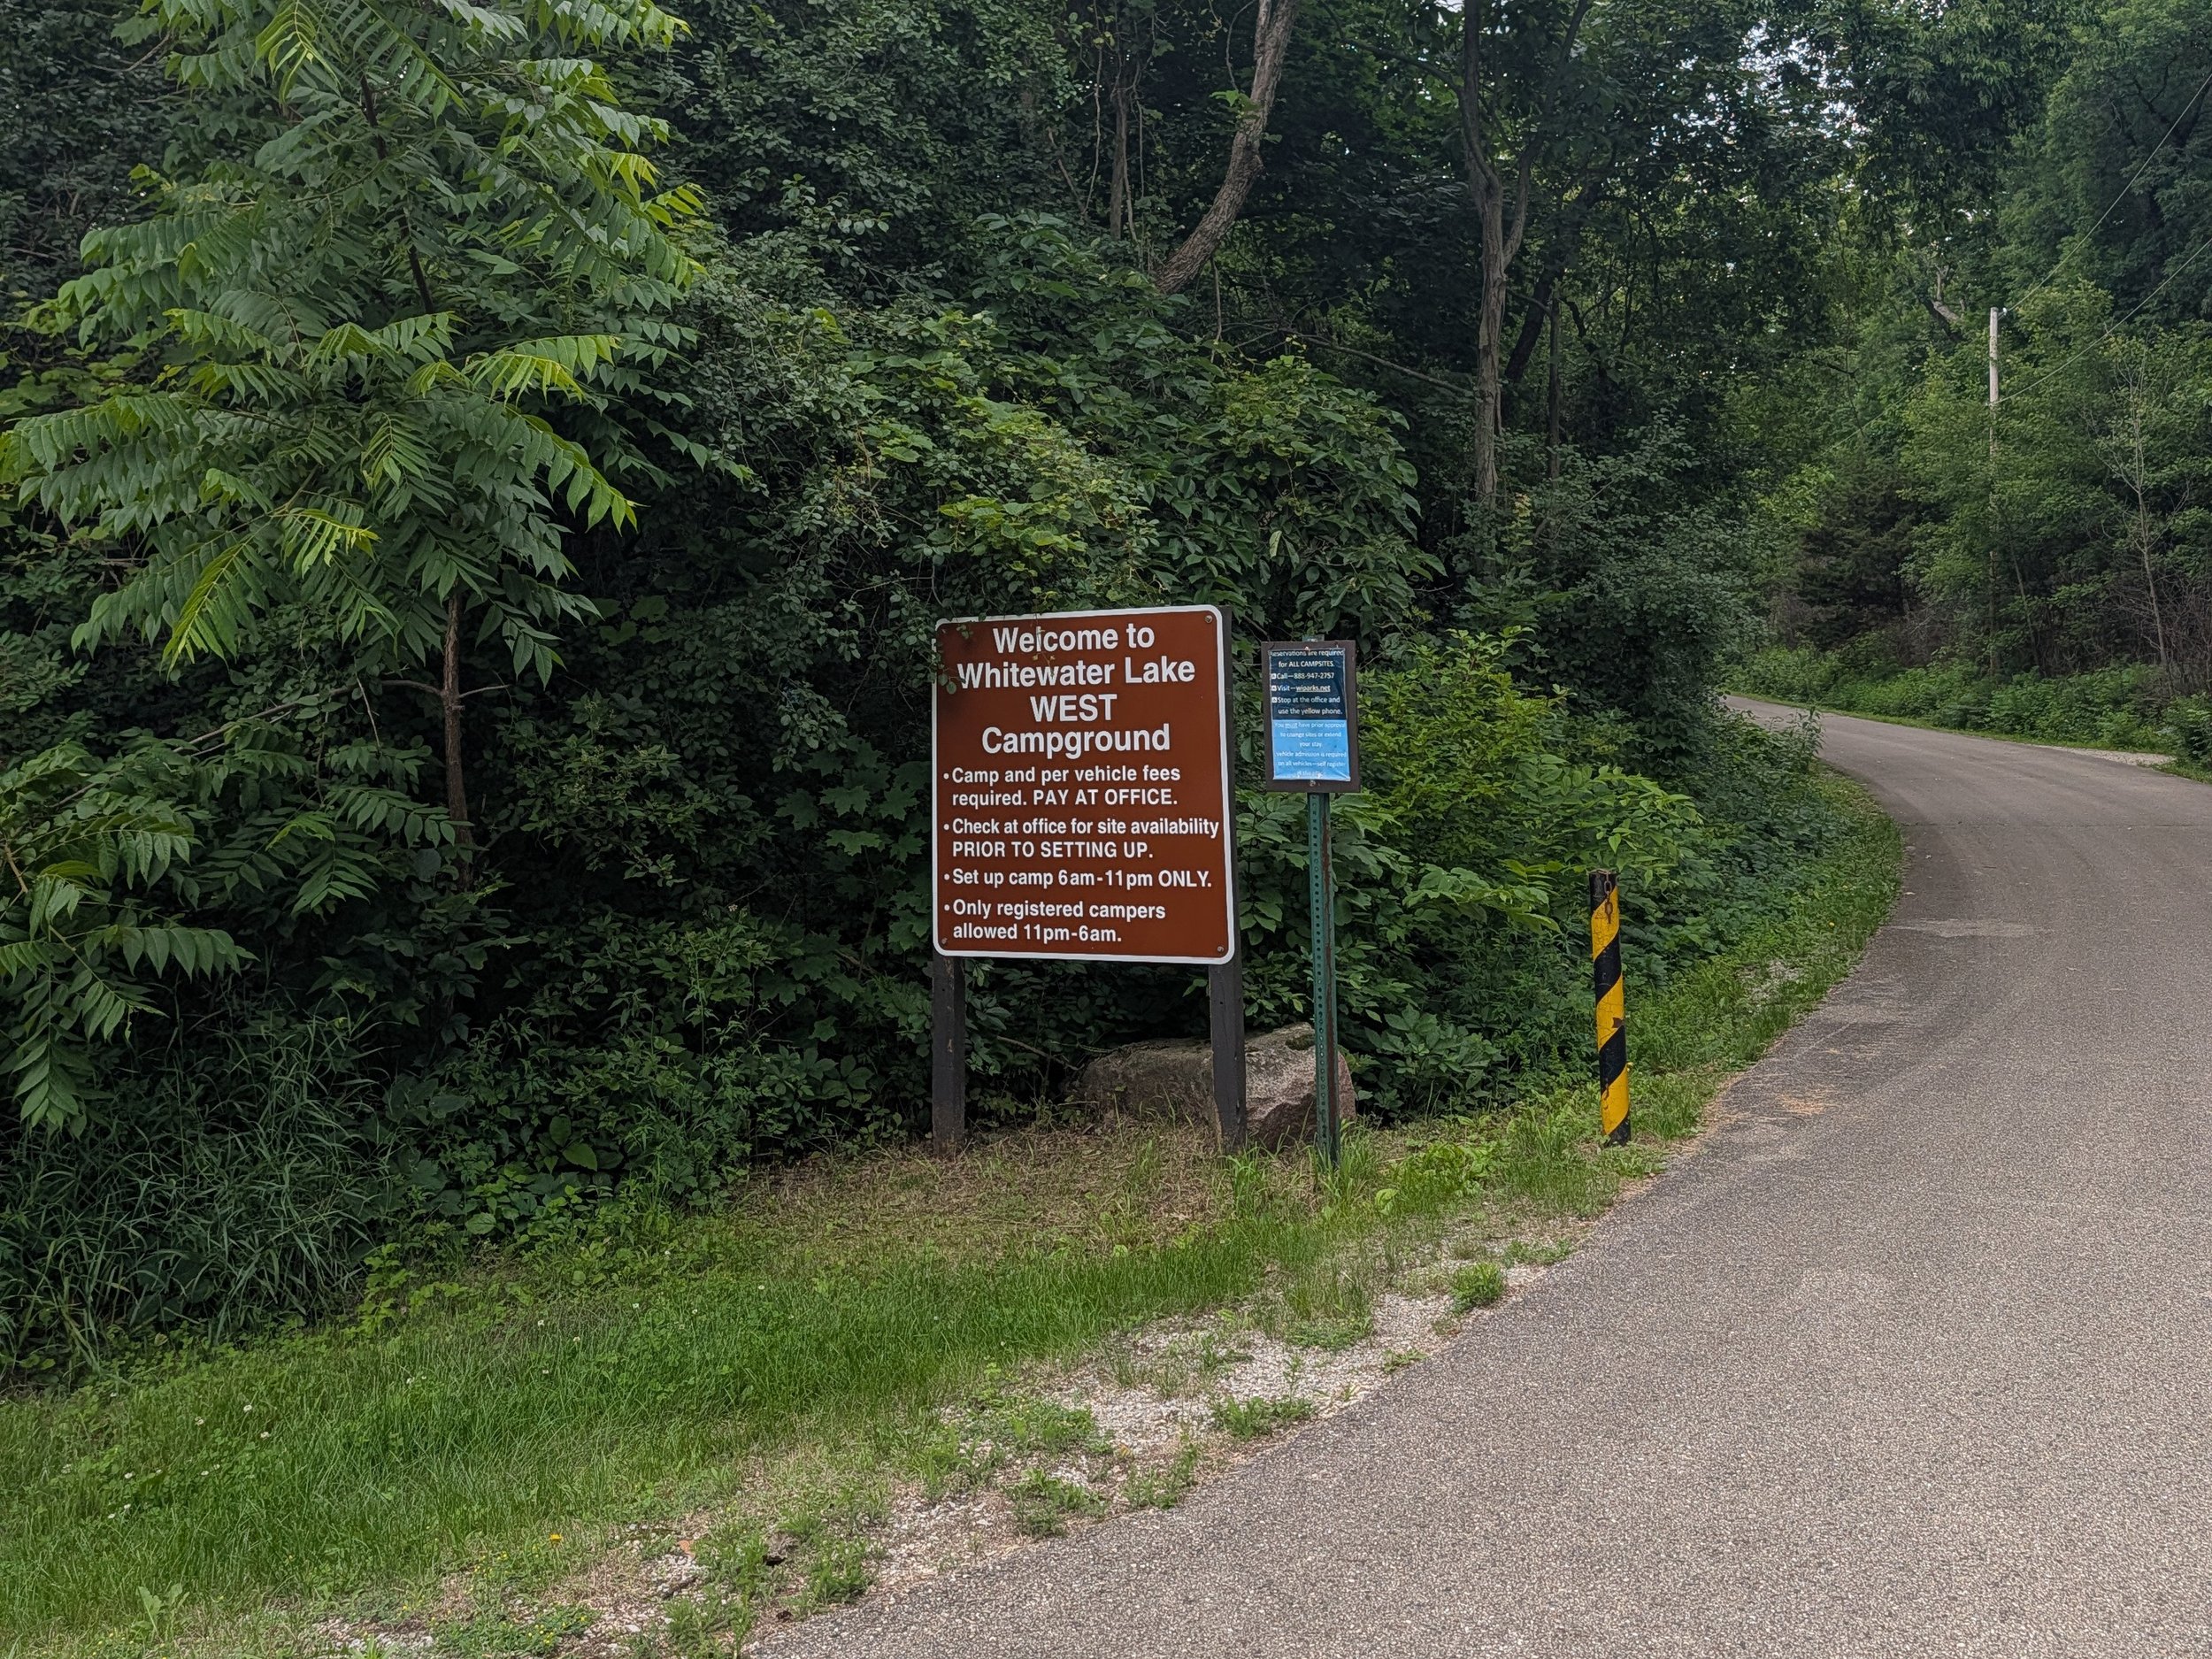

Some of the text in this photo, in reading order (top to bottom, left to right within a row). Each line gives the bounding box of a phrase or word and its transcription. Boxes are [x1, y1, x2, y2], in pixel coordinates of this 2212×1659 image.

[993, 623, 1155, 654] Welcome to
[956, 656, 1194, 689] Whitewater Lake
[1030, 694, 1118, 722] WEST
[982, 724, 1170, 758] Campground
[952, 765, 1180, 787] Camp and per vehicle fees
[952, 788, 1178, 810] required. PAY AT OFFICE.
[952, 818, 1218, 838] Check at office for site availability
[952, 841, 1153, 858] PRIOR TO SETTING UP.
[953, 869, 979, 885] Set
[985, 871, 1003, 889] up
[1009, 871, 1053, 889] camp
[1158, 871, 1212, 887] ONLY.
[953, 900, 1165, 922] Only registered campers
[953, 924, 1122, 942] allowed 11pm-6am.
